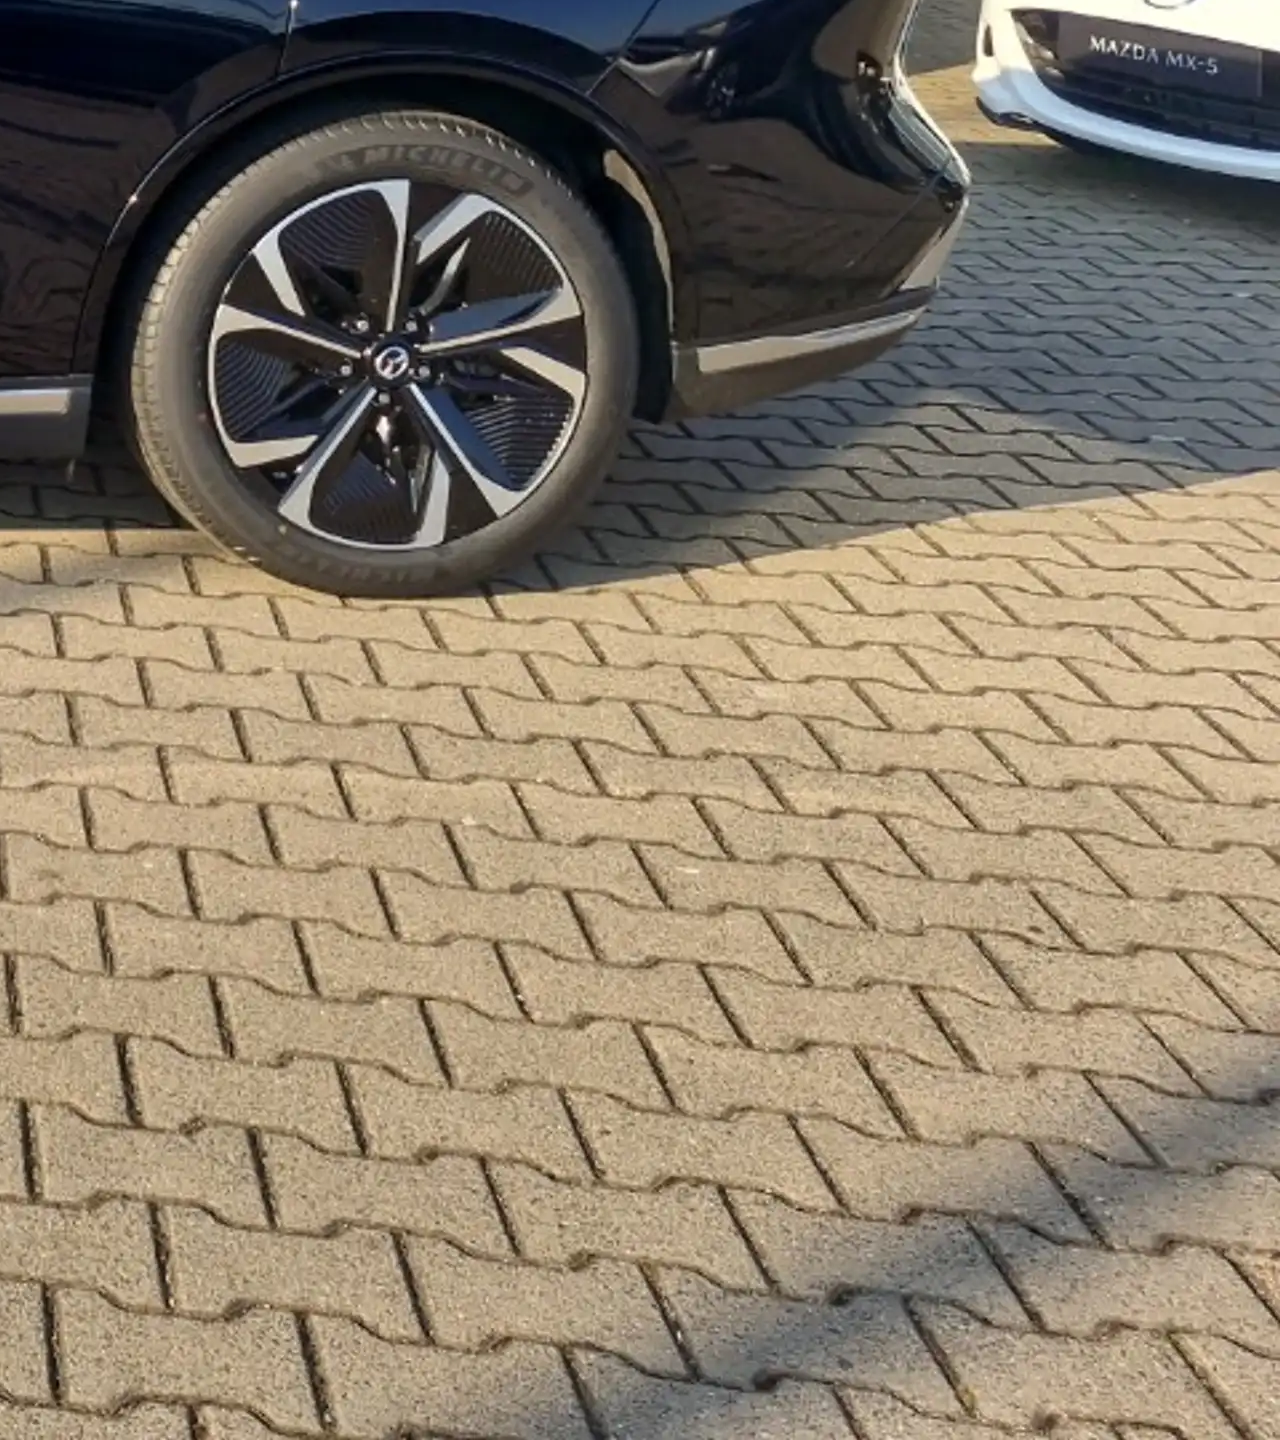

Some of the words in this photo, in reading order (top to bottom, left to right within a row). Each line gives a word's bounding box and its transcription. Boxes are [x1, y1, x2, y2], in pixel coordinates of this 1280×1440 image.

[1089, 34, 1159, 64] MAZDA
[1165, 49, 1219, 75] MX-5
[363, 145, 526, 192] MICHELIN
